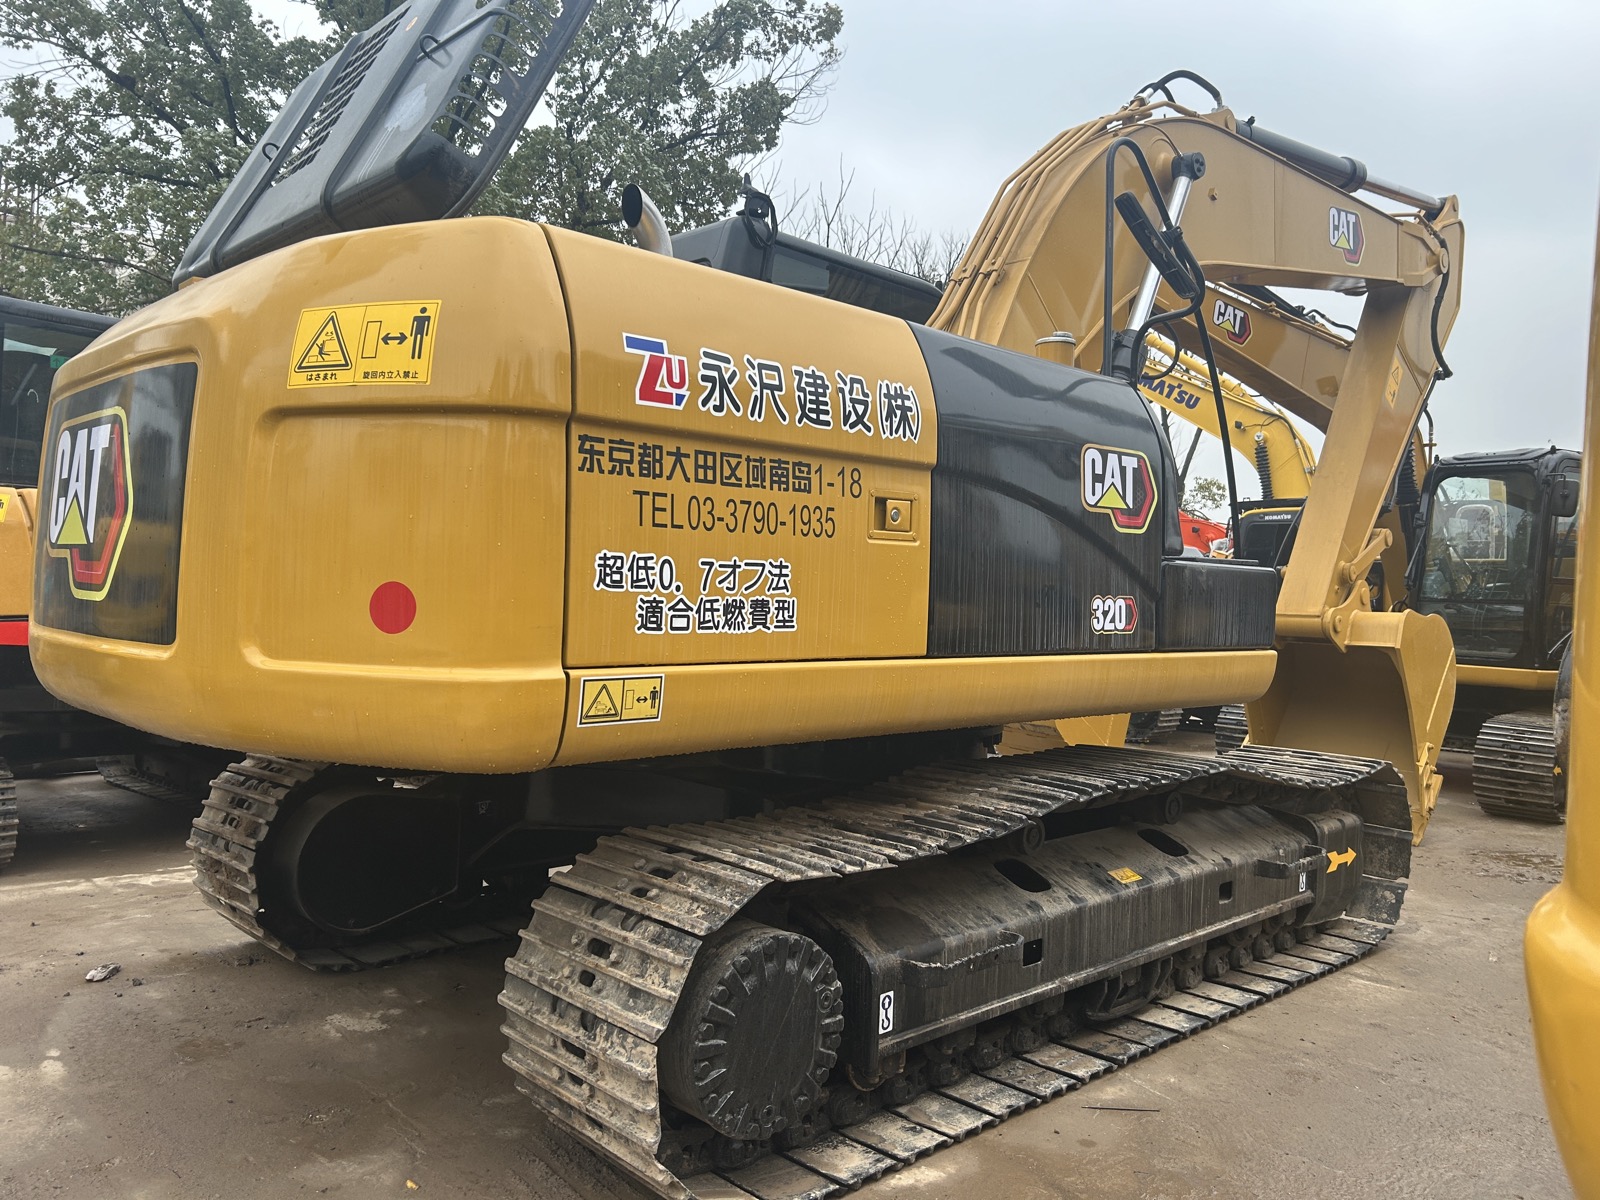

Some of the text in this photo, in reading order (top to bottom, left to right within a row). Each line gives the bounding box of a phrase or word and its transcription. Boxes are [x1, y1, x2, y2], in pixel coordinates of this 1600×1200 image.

[1329, 207, 1356, 250] CAT
[1213, 299, 1245, 335] CAT
[306, 372, 338, 382] はさまれ
[1138, 371, 1201, 410] MATSU
[50, 423, 112, 544] CAT
[1084, 448, 1138, 509] CAT
[1264, 513, 1292, 521] KOMATSU
[636, 597, 796, 632] 適合低燃費型
[1092, 598, 1126, 631] 320
